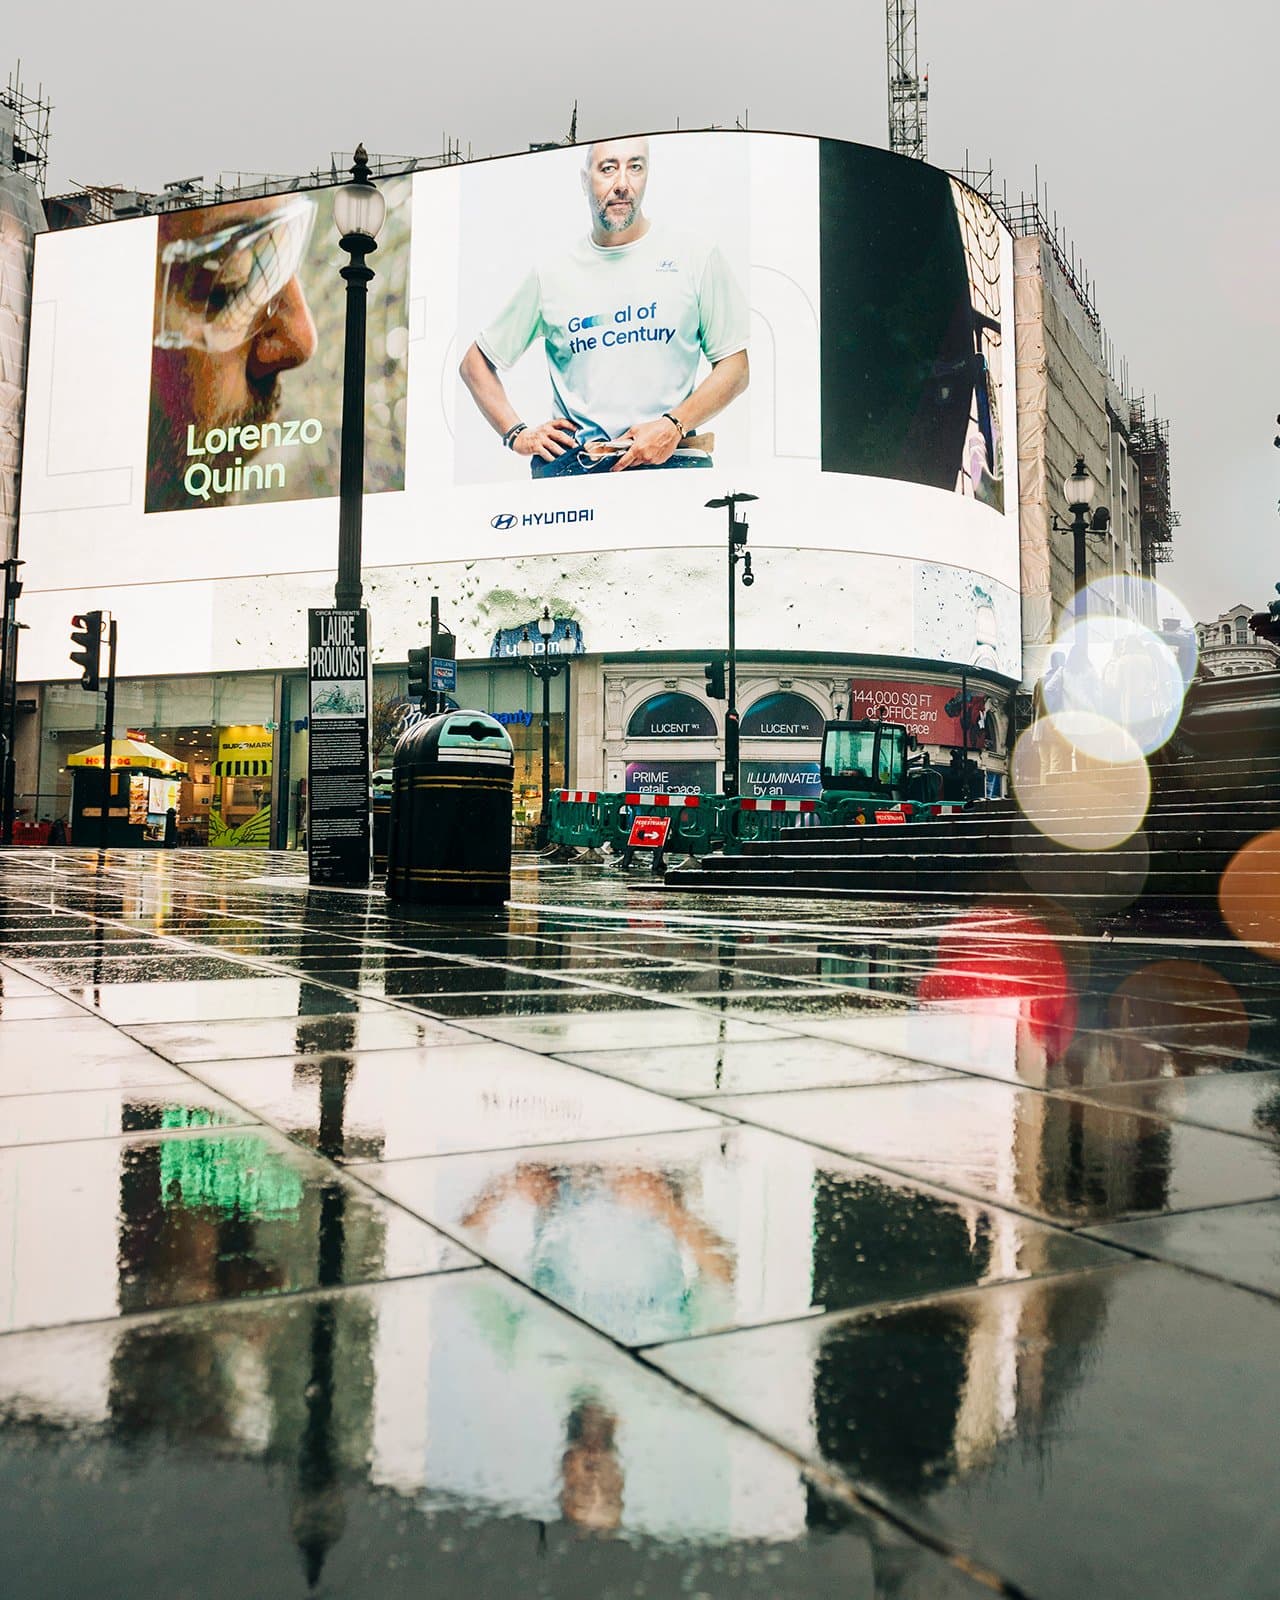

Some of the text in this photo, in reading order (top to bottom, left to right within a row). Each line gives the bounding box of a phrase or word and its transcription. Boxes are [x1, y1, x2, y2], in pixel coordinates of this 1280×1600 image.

[637, 302, 657, 319] of
[569, 326, 676, 354] the Century
[187, 418, 322, 456] Lorenzo
[184, 457, 286, 501] Quinn
[522, 509, 594, 526] HYUNDAI
[321, 615, 355, 646] LAURE
[311, 646, 366, 677] PROUVOST
[853, 690, 932, 707] 144,000 SQ FT
[488, 709, 533, 727] eauty
[919, 710, 938, 722] and
[651, 723, 690, 733] LUCENT
[761, 723, 800, 733] LUCENT
[905, 723, 930, 735] pace
[632, 771, 669, 783] PRIME
[747, 772, 821, 784] ILLUMINATED
[639, 783, 664, 793] retail
[753, 784, 783, 796] by an
